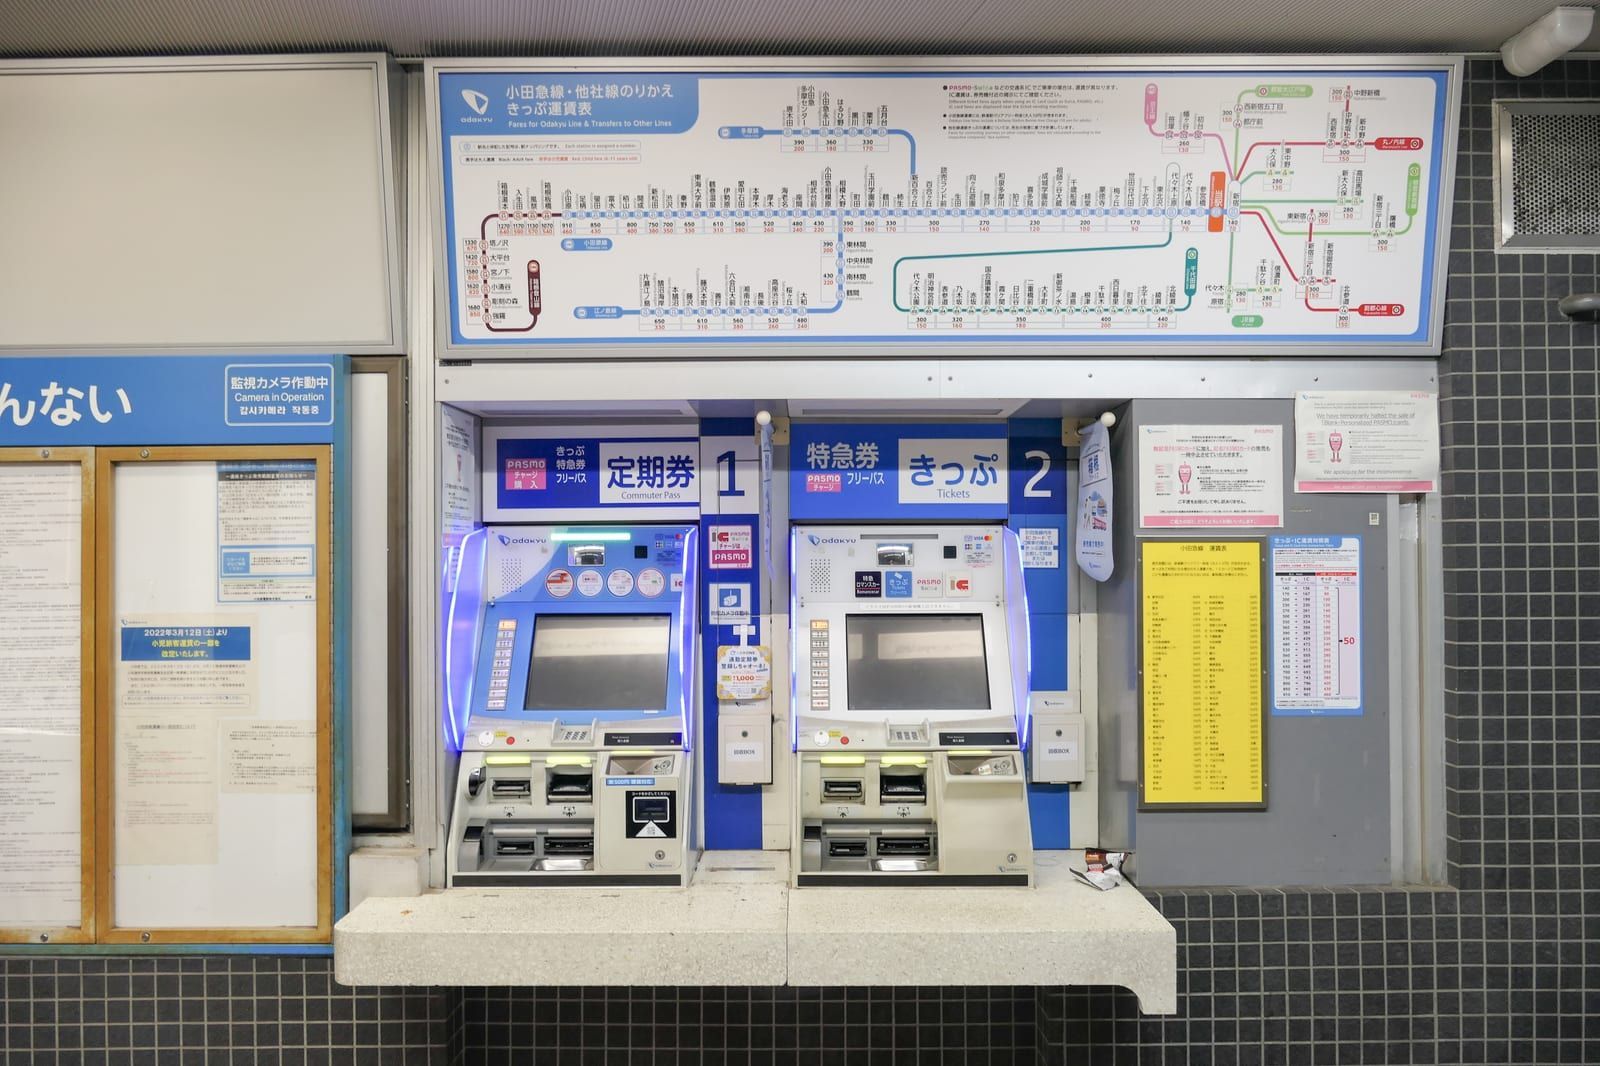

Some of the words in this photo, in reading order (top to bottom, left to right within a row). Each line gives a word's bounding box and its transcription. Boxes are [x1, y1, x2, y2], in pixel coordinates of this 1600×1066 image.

[506, 84, 674, 100] 小田急線・他社線のりかえ
[506, 102, 592, 116] きっぷ運賃表
[540, 120, 566, 129] Odakyu
[231, 376, 328, 389] 監視カメラ作動中
[234, 393, 270, 402] Camera
[272, 393, 280, 401] in
[281, 392, 324, 403] Operation
[556, 446, 586, 456] きっぷ
[807, 442, 879, 470] 特急券
[507, 460, 545, 469] PASMO
[556, 459, 586, 470] 特急券
[909, 454, 998, 486] きっぷ
[514, 471, 538, 479] チャージ
[556, 472, 587, 484] フリーパス
[607, 455, 696, 489] 定期券
[717, 450, 745, 496] 1
[1024, 450, 1052, 497] 2
[847, 472, 884, 485] フリーパス
[621, 491, 661, 500] Commuter
[664, 491, 680, 500] Pass
[936, 489, 970, 498] Tickets
